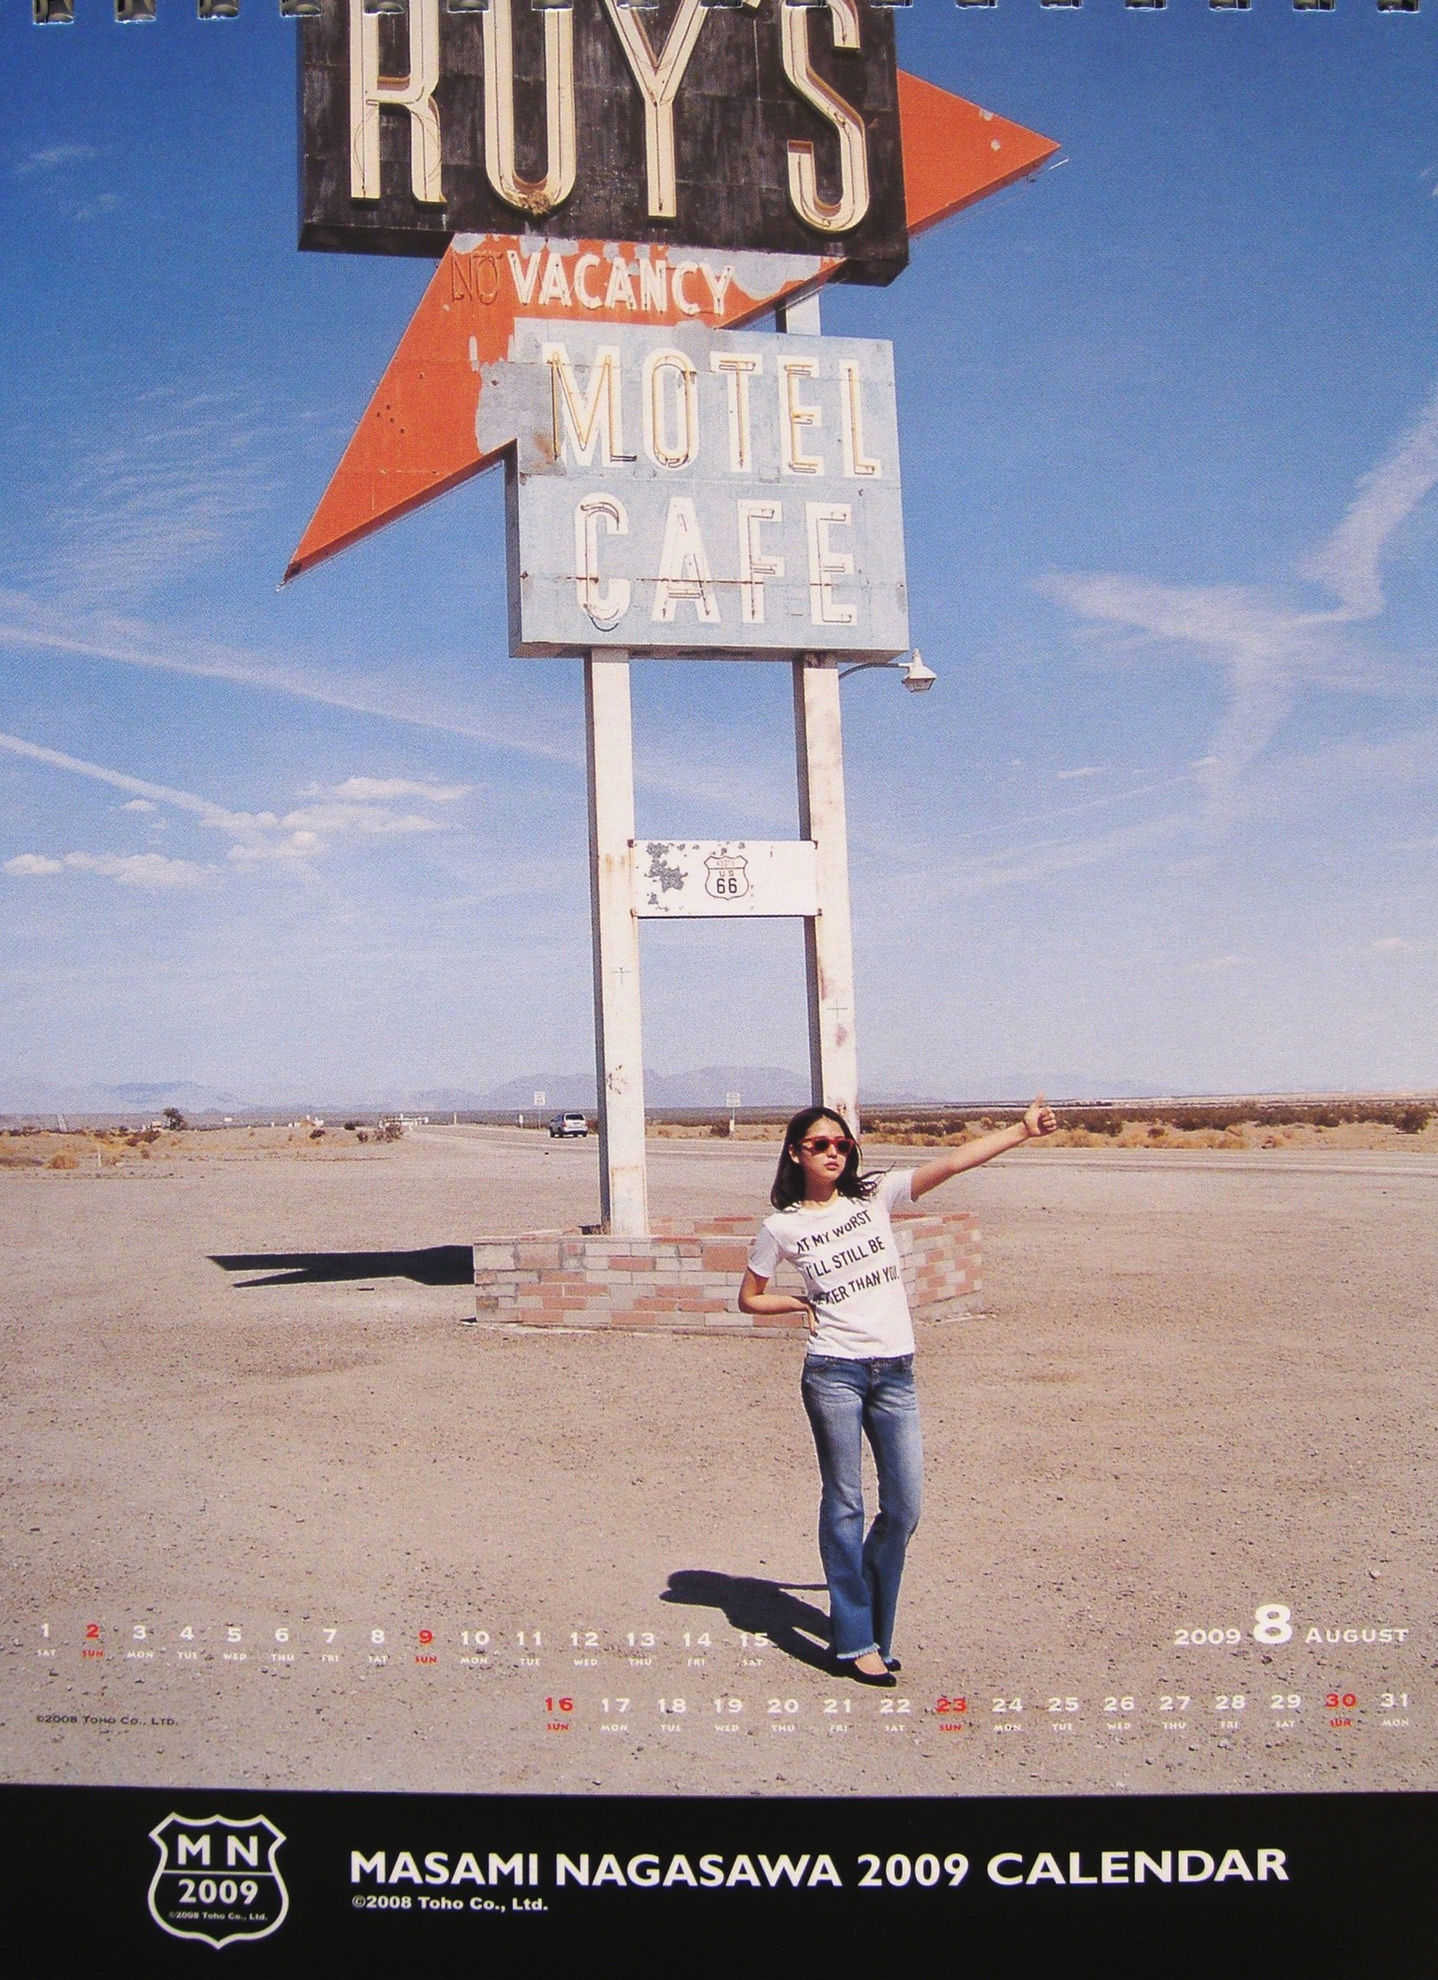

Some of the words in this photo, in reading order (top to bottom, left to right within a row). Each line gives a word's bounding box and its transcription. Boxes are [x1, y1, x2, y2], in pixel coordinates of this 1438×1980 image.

[350, 0, 869, 233] ROYS
[451, 252, 502, 305] NO
[507, 250, 734, 316] VACANCY
[541, 341, 881, 478] MOTEL
[574, 492, 858, 632] CAFE
[716, 877, 737, 894] 66
[797, 1237, 809, 1254] AT
[811, 1232, 830, 1247] MY
[832, 1210, 872, 1237] WORST
[806, 1260, 831, 1280] I'LL
[831, 1246, 868, 1269] STILL
[869, 1236, 885, 1254] BE
[848, 1270, 881, 1293] THAN
[40, 1623, 50, 1638] 1
[86, 1624, 99, 1639] 2
[132, 1625, 147, 1640] 3
[180, 1626, 195, 1641] 4
[227, 1627, 242, 1642] 5
[274, 1627, 290, 1642] 6
[322, 1628, 338, 1643] 7
[370, 1628, 385, 1644] 8
[419, 1630, 433, 1645] 9
[461, 1630, 490, 1646] 10
[517, 1631, 542, 1646] 11
[570, 1632, 599, 1647] 12
[627, 1632, 656, 1647] 13
[682, 1632, 712, 1647] 14
[740, 1632, 768, 1647] 15
[1174, 1628, 1241, 1646] 2009
[1253, 1604, 1293, 1644] 8
[1305, 1627, 1409, 1644] AUGUST
[36, 1649, 56, 1657] SAT
[81, 1649, 104, 1658] SUN
[127, 1650, 154, 1659] MON
[177, 1651, 198, 1660] TUE
[223, 1653, 247, 1661] WED
[271, 1653, 295, 1662] THU
[321, 1654, 339, 1663] FRI
[368, 1655, 388, 1664] SAT
[415, 1656, 437, 1664] SUN
[460, 1657, 488, 1665] MON
[520, 1658, 541, 1666] TUE
[573, 1658, 598, 1666] WED
[628, 1658, 652, 1667] THU
[687, 1659, 706, 1667] FRI
[742, 1659, 764, 1667] SAT
[545, 1697, 573, 1712] 16
[601, 1698, 631, 1713] 17
[658, 1698, 687, 1713] 18
[714, 1698, 743, 1713] 19
[767, 1698, 799, 1713] 20
[823, 1698, 851, 1714] 21
[880, 1698, 911, 1713] 22
[936, 1698, 967, 1713] 23
[992, 1697, 1024, 1713] 24
[1049, 1697, 1079, 1712] 25
[1104, 1696, 1135, 1711] 26
[1160, 1695, 1191, 1711] 27
[1215, 1695, 1246, 1710] 28
[1270, 1694, 1301, 1709] 29
[1326, 1693, 1357, 1708] 30
[1380, 1693, 1409, 1707] 31
[547, 1723, 569, 1731] SUN
[600, 1724, 628, 1732] MON
[661, 1724, 681, 1732] TUE
[715, 1724, 739, 1732] WED
[771, 1724, 795, 1732] THU
[830, 1724, 848, 1732] FRI
[885, 1724, 905, 1732] SAT
[938, 1724, 962, 1732] SUN
[994, 1724, 1021, 1732] MON
[1052, 1723, 1073, 1731] TUE
[1107, 1722, 1131, 1730] WED
[1163, 1722, 1186, 1730] THU
[1220, 1721, 1239, 1729] FRI
[1275, 1720, 1296, 1728] SAT
[1330, 1719, 1352, 1727] SUN
[1382, 1718, 1410, 1727] MON
[351, 1851, 538, 1885] MASAMI
[556, 1852, 842, 1887] NAGASAWA
[857, 1852, 969, 1887] 2009
[987, 1848, 1289, 1885] CALENDAR
[178, 1878, 258, 1904] 2009
[352, 1895, 412, 1909] ©2008
[418, 1896, 463, 1910] Toho
[469, 1897, 505, 1912] Co.,
[512, 1898, 548, 1911] Ltd.
[202, 1912, 225, 1920] Toho
[249, 1913, 268, 1921] Ltd.
